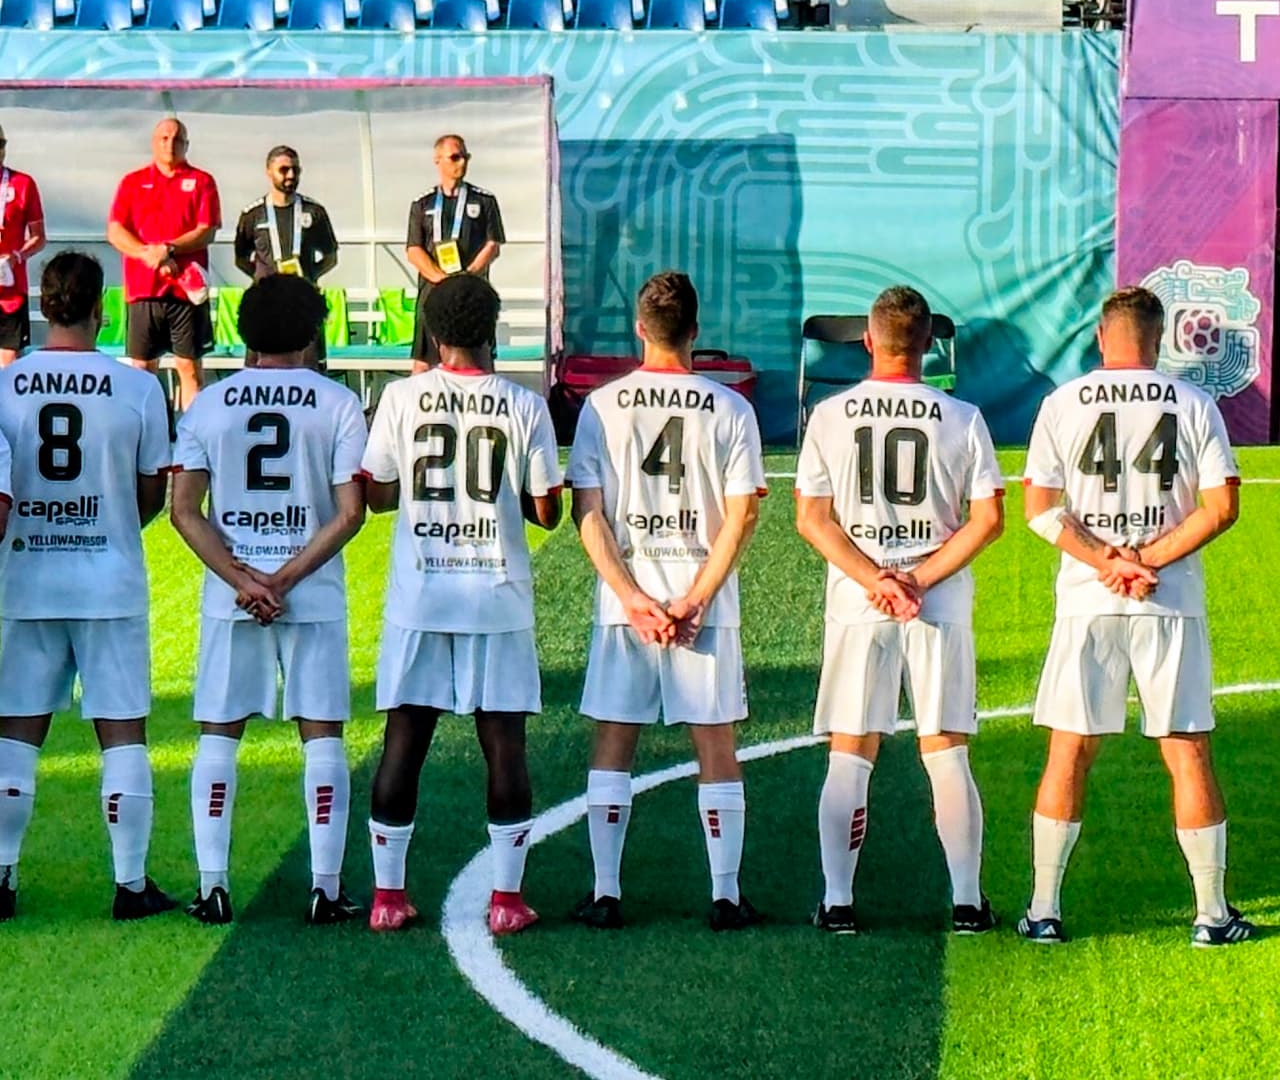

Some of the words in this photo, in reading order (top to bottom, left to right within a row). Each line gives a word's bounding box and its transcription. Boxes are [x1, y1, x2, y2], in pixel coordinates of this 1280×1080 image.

[14, 372, 113, 397] CANADA
[223, 385, 317, 409] CANADA
[1078, 383, 1178, 405] CANADA
[419, 391, 510, 418] CANADA
[617, 387, 716, 414] CANADA
[844, 398, 943, 422] CANADA
[37, 402, 83, 481] 8
[246, 411, 291, 491] 2
[641, 415, 686, 495] 4
[1077, 411, 1180, 493] 44
[412, 423, 508, 504] 20
[854, 425, 930, 506] 10
[17, 495, 99, 523] capelli
[55, 517, 97, 526] SPORT
[222, 505, 307, 533] capelli
[626, 509, 699, 536] capelli
[1083, 505, 1165, 535] capelli
[258, 527, 306, 536] SPORT
[413, 517, 498, 544] capelli
[849, 519, 932, 547] capelli
